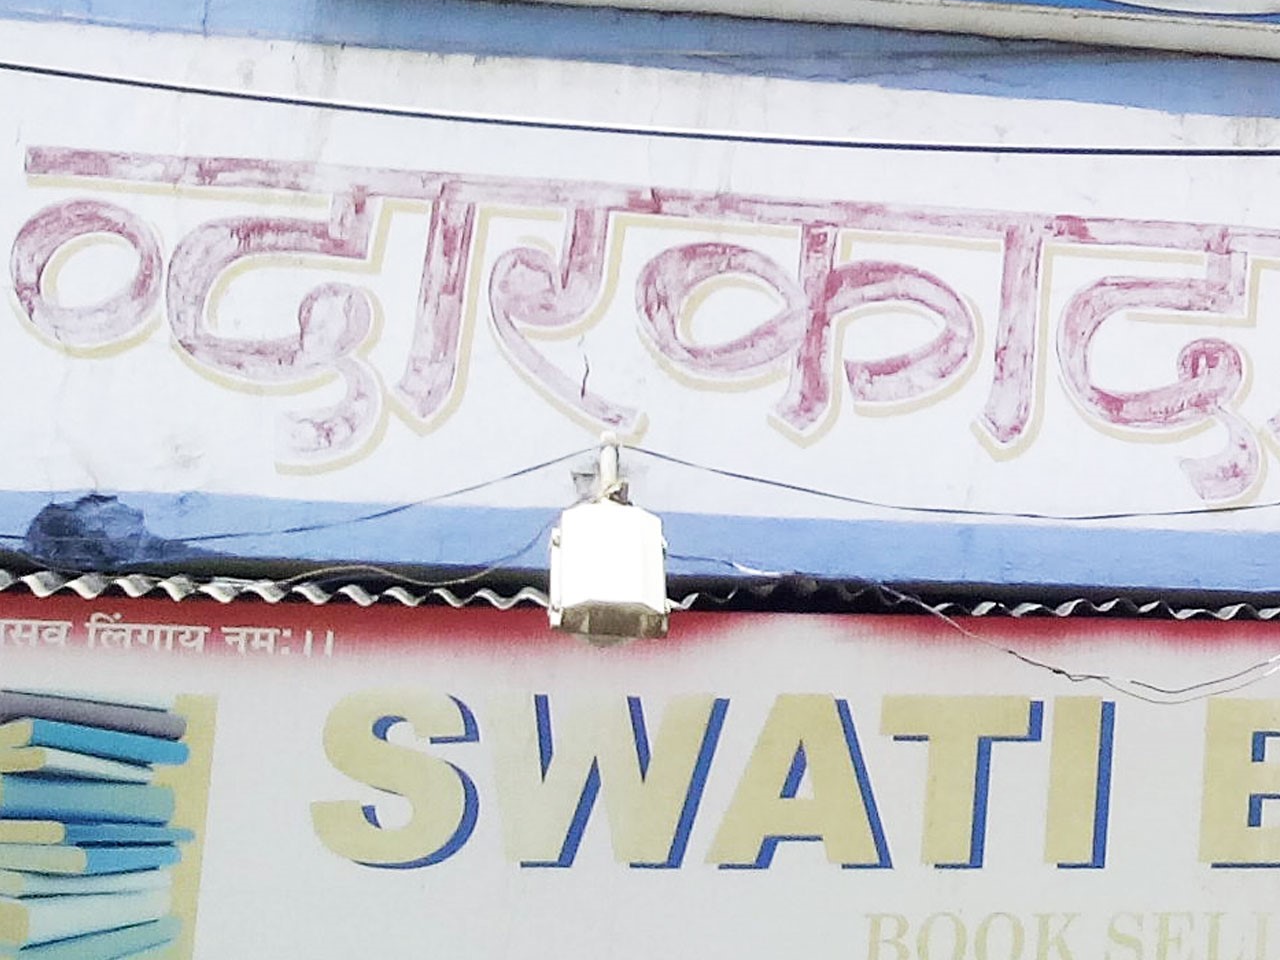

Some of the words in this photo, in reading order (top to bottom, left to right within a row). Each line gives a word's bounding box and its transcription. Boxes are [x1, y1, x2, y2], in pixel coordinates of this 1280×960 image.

[0, 619, 73, 648] सव
[309, 685, 1116, 871] SWATI
[865, 910, 1084, 960] BOOK
